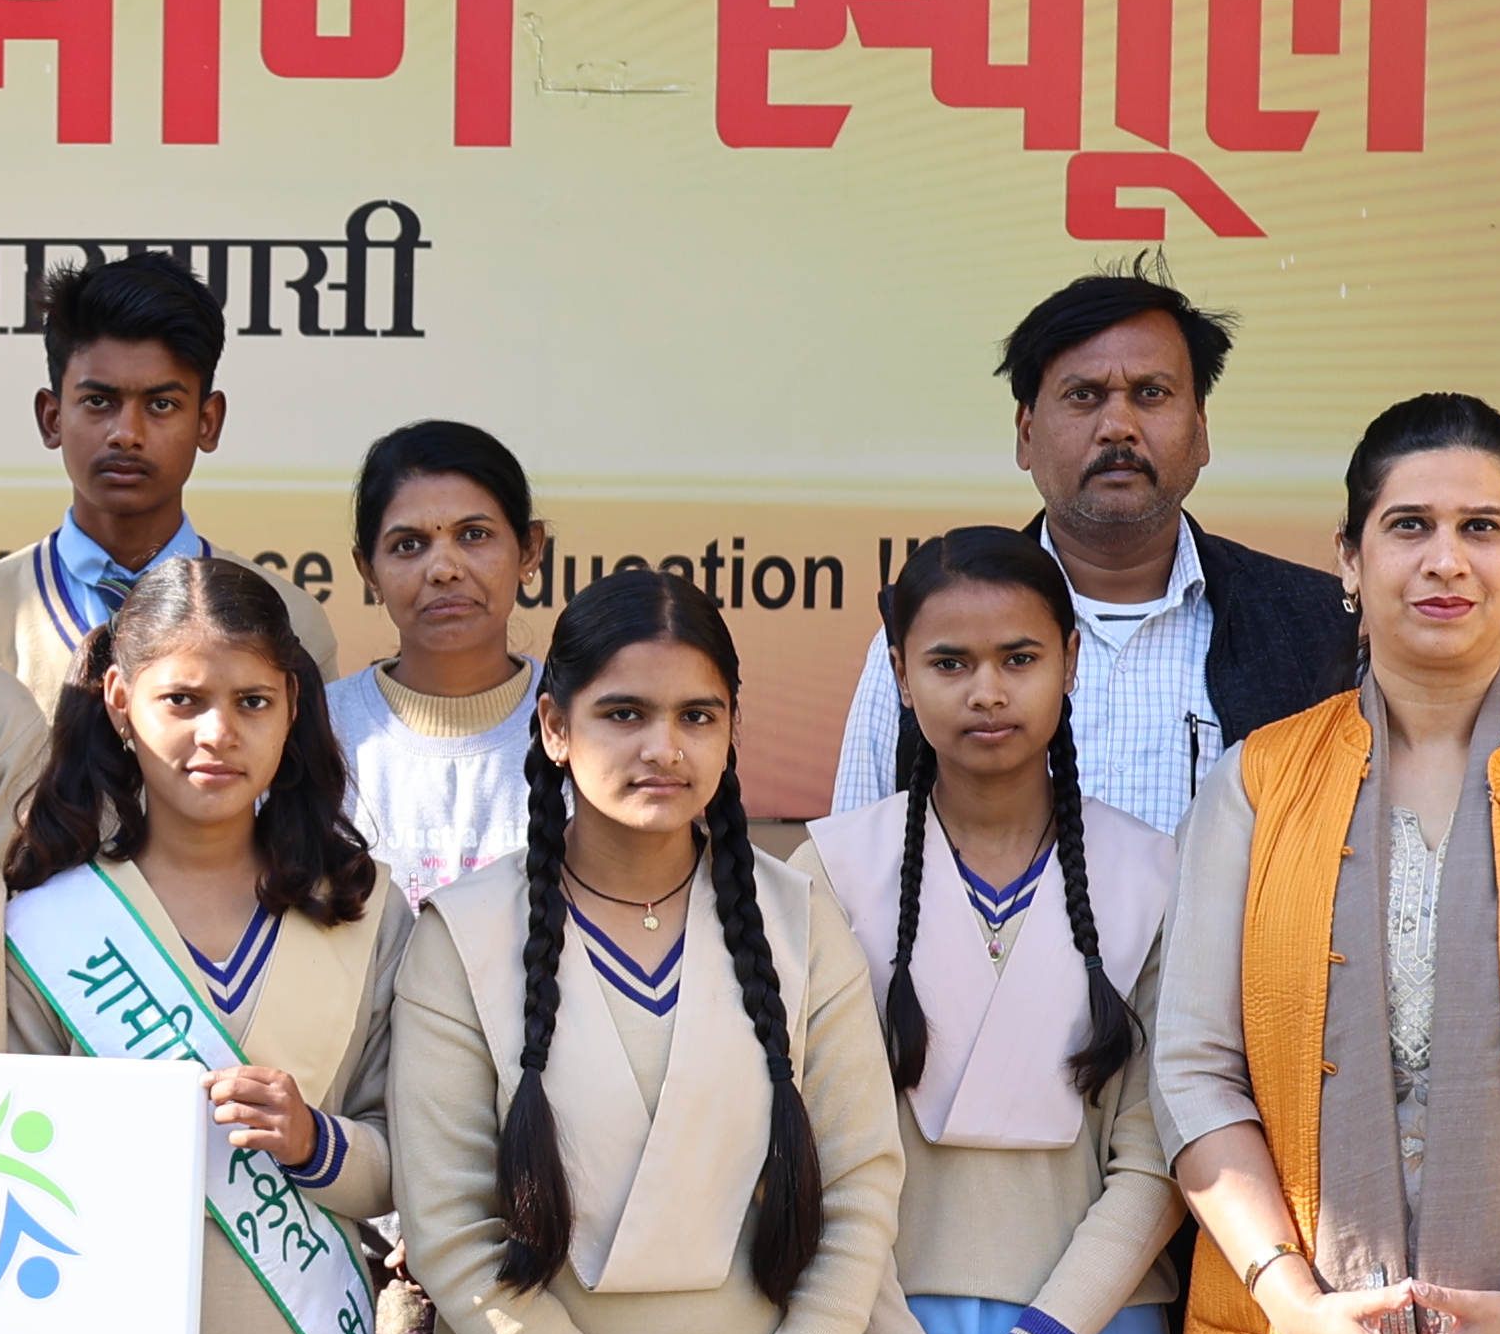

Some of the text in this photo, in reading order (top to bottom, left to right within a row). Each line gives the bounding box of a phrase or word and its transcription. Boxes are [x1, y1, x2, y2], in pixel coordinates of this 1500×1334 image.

[387, 823, 454, 850] Just
[462, 828, 477, 849] a
[421, 854, 496, 869] who loves
